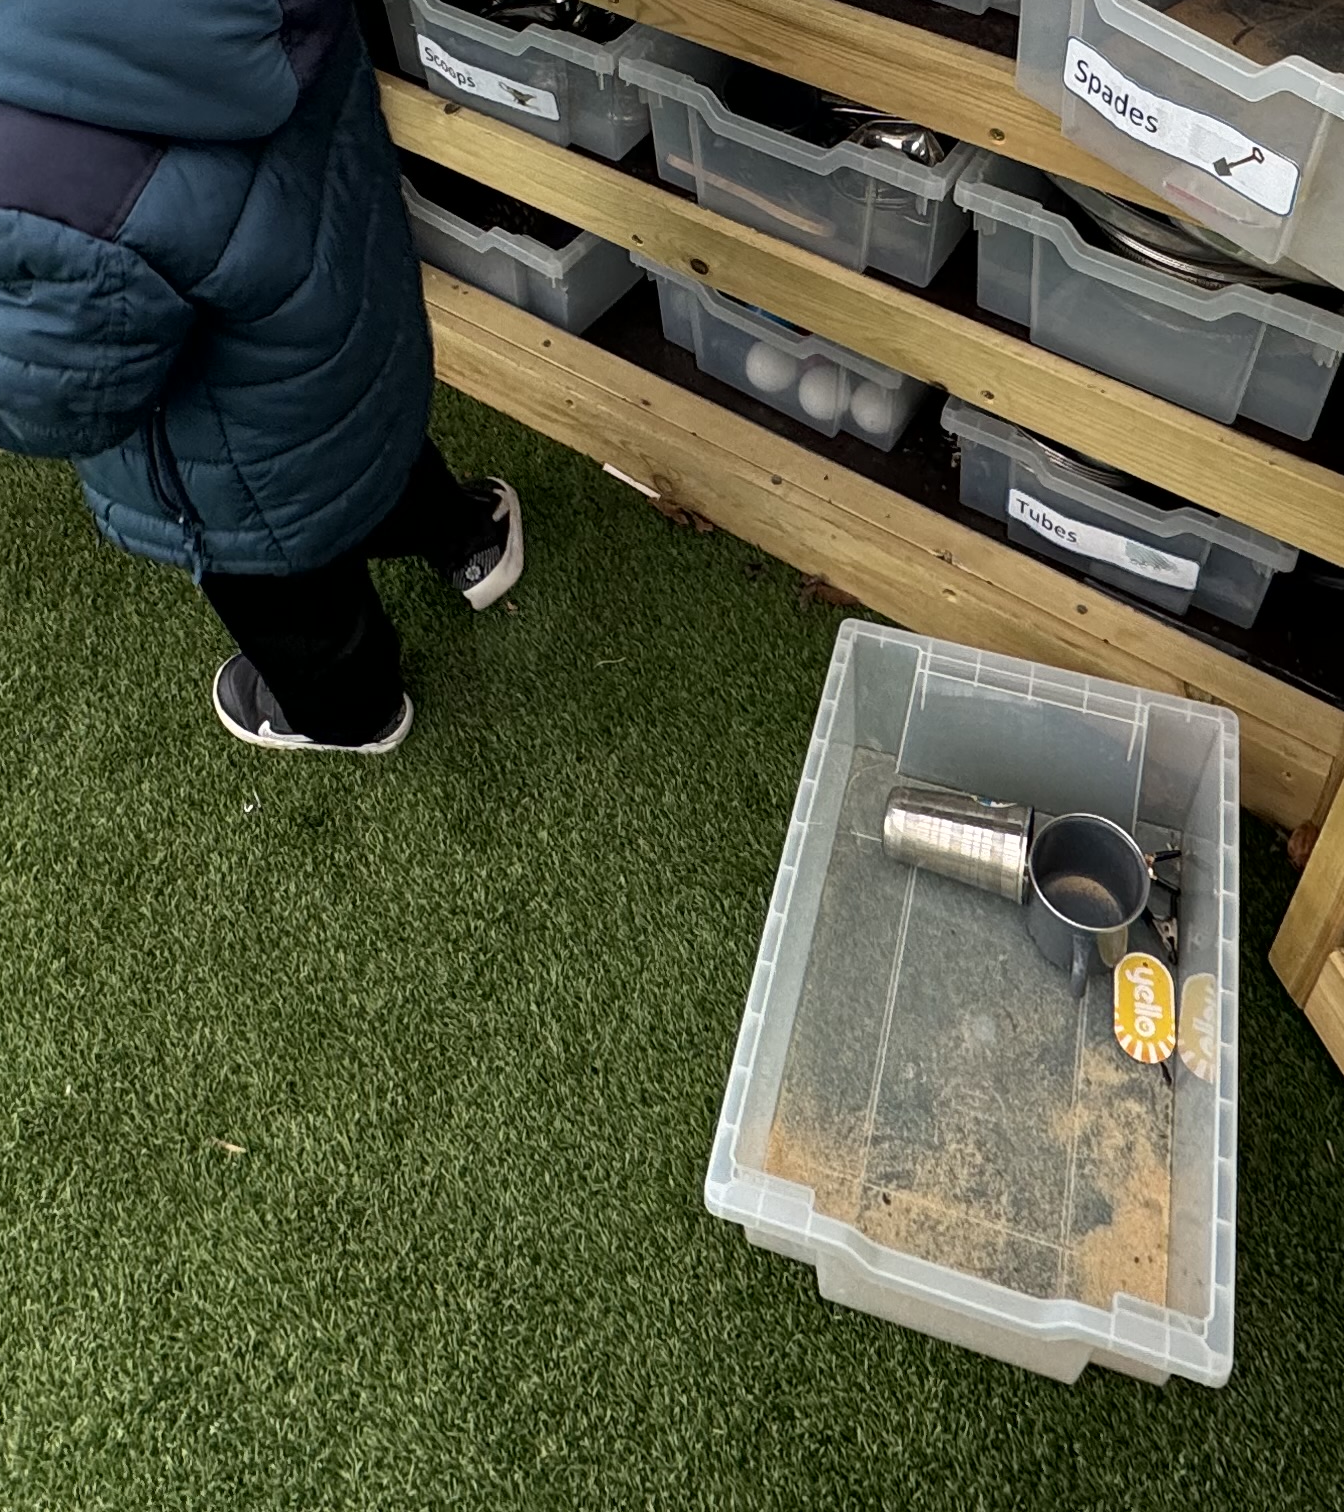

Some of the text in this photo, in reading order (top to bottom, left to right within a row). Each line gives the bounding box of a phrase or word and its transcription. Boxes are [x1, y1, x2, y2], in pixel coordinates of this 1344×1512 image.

[424, 46, 476, 88] Scoops
[1074, 59, 1159, 134] Spades
[1016, 498, 1078, 544] Tubes
[1125, 966, 1163, 1038] yello
